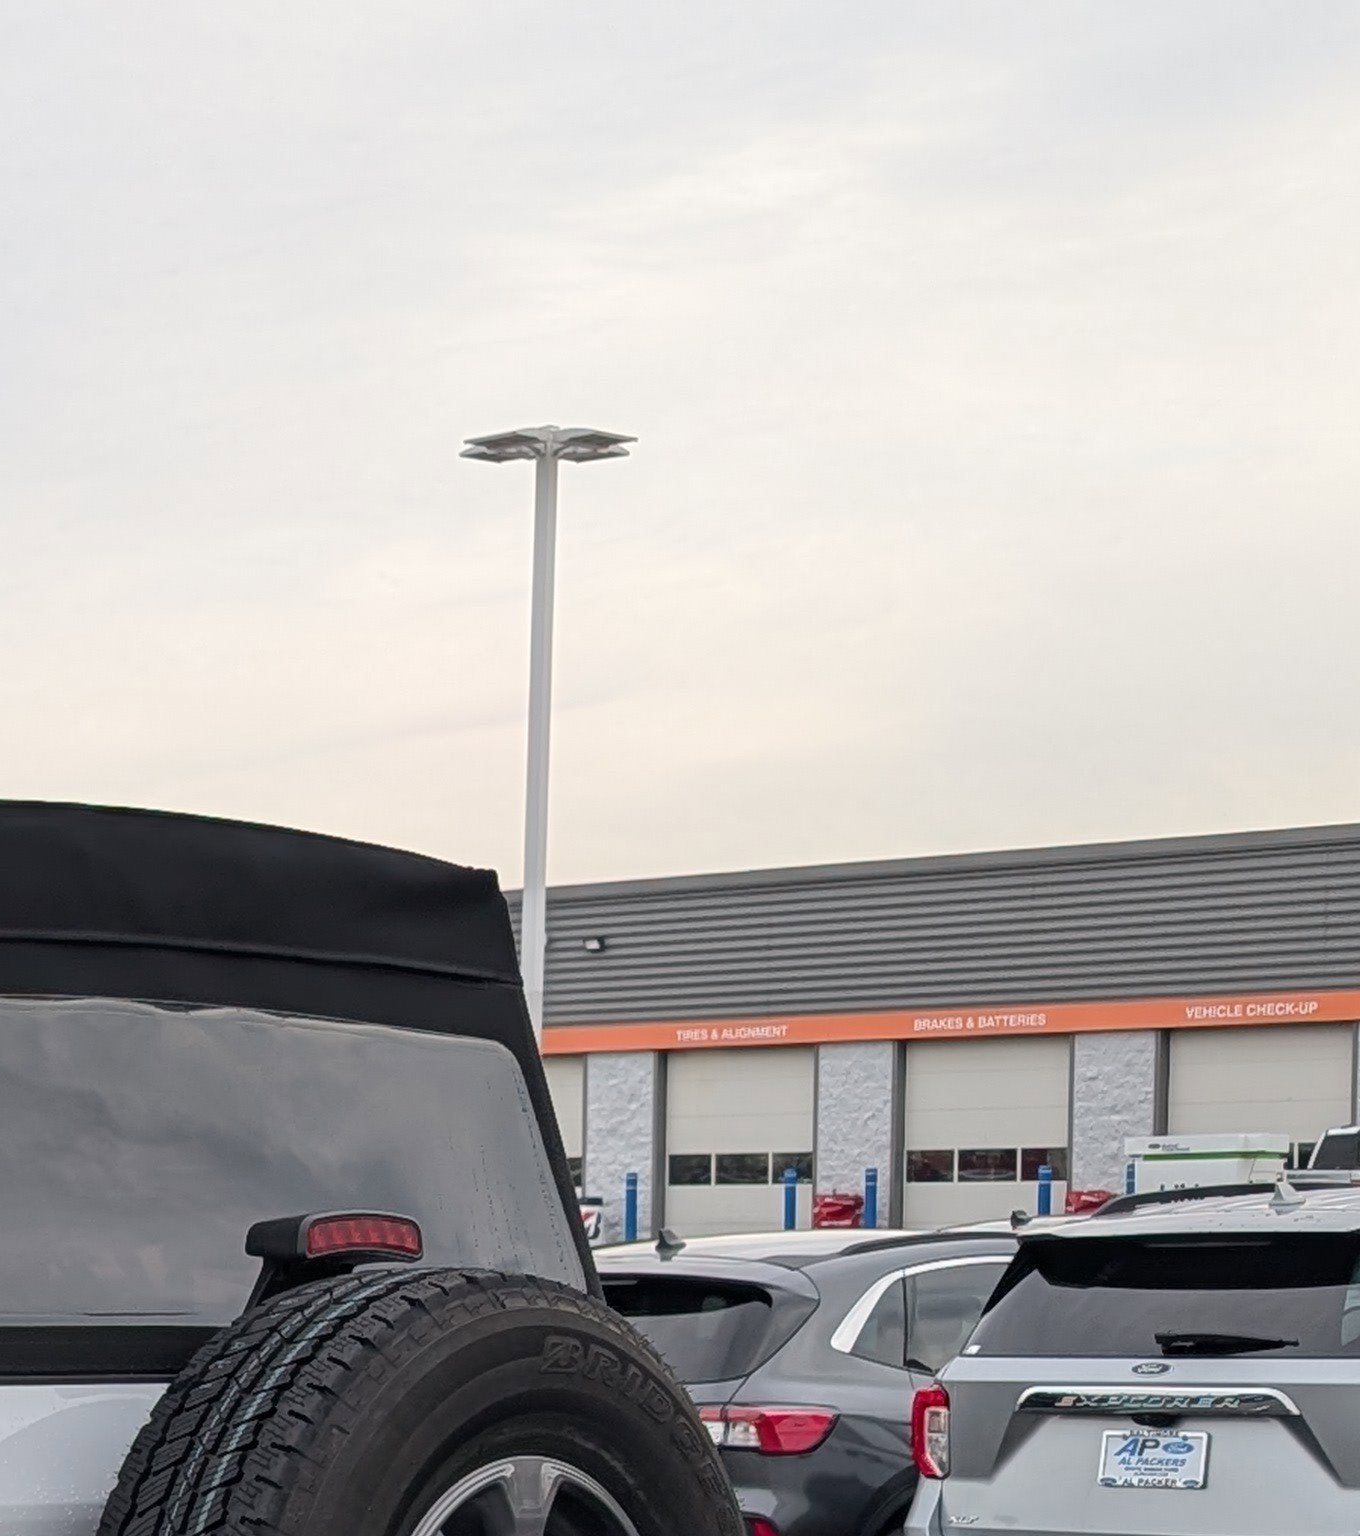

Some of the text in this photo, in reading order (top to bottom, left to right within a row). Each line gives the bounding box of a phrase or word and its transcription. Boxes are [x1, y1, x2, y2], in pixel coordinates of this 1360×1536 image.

[1184, 1001, 1319, 1019] VEHICLE CHECK-UP
[913, 1013, 1047, 1031] BRAKES & BATTERIES
[676, 1025, 788, 1041] TIRES & ALIGNMENT
[1055, 1396, 1240, 1408] EXPLORER
[1114, 1438, 1161, 1457] AP
